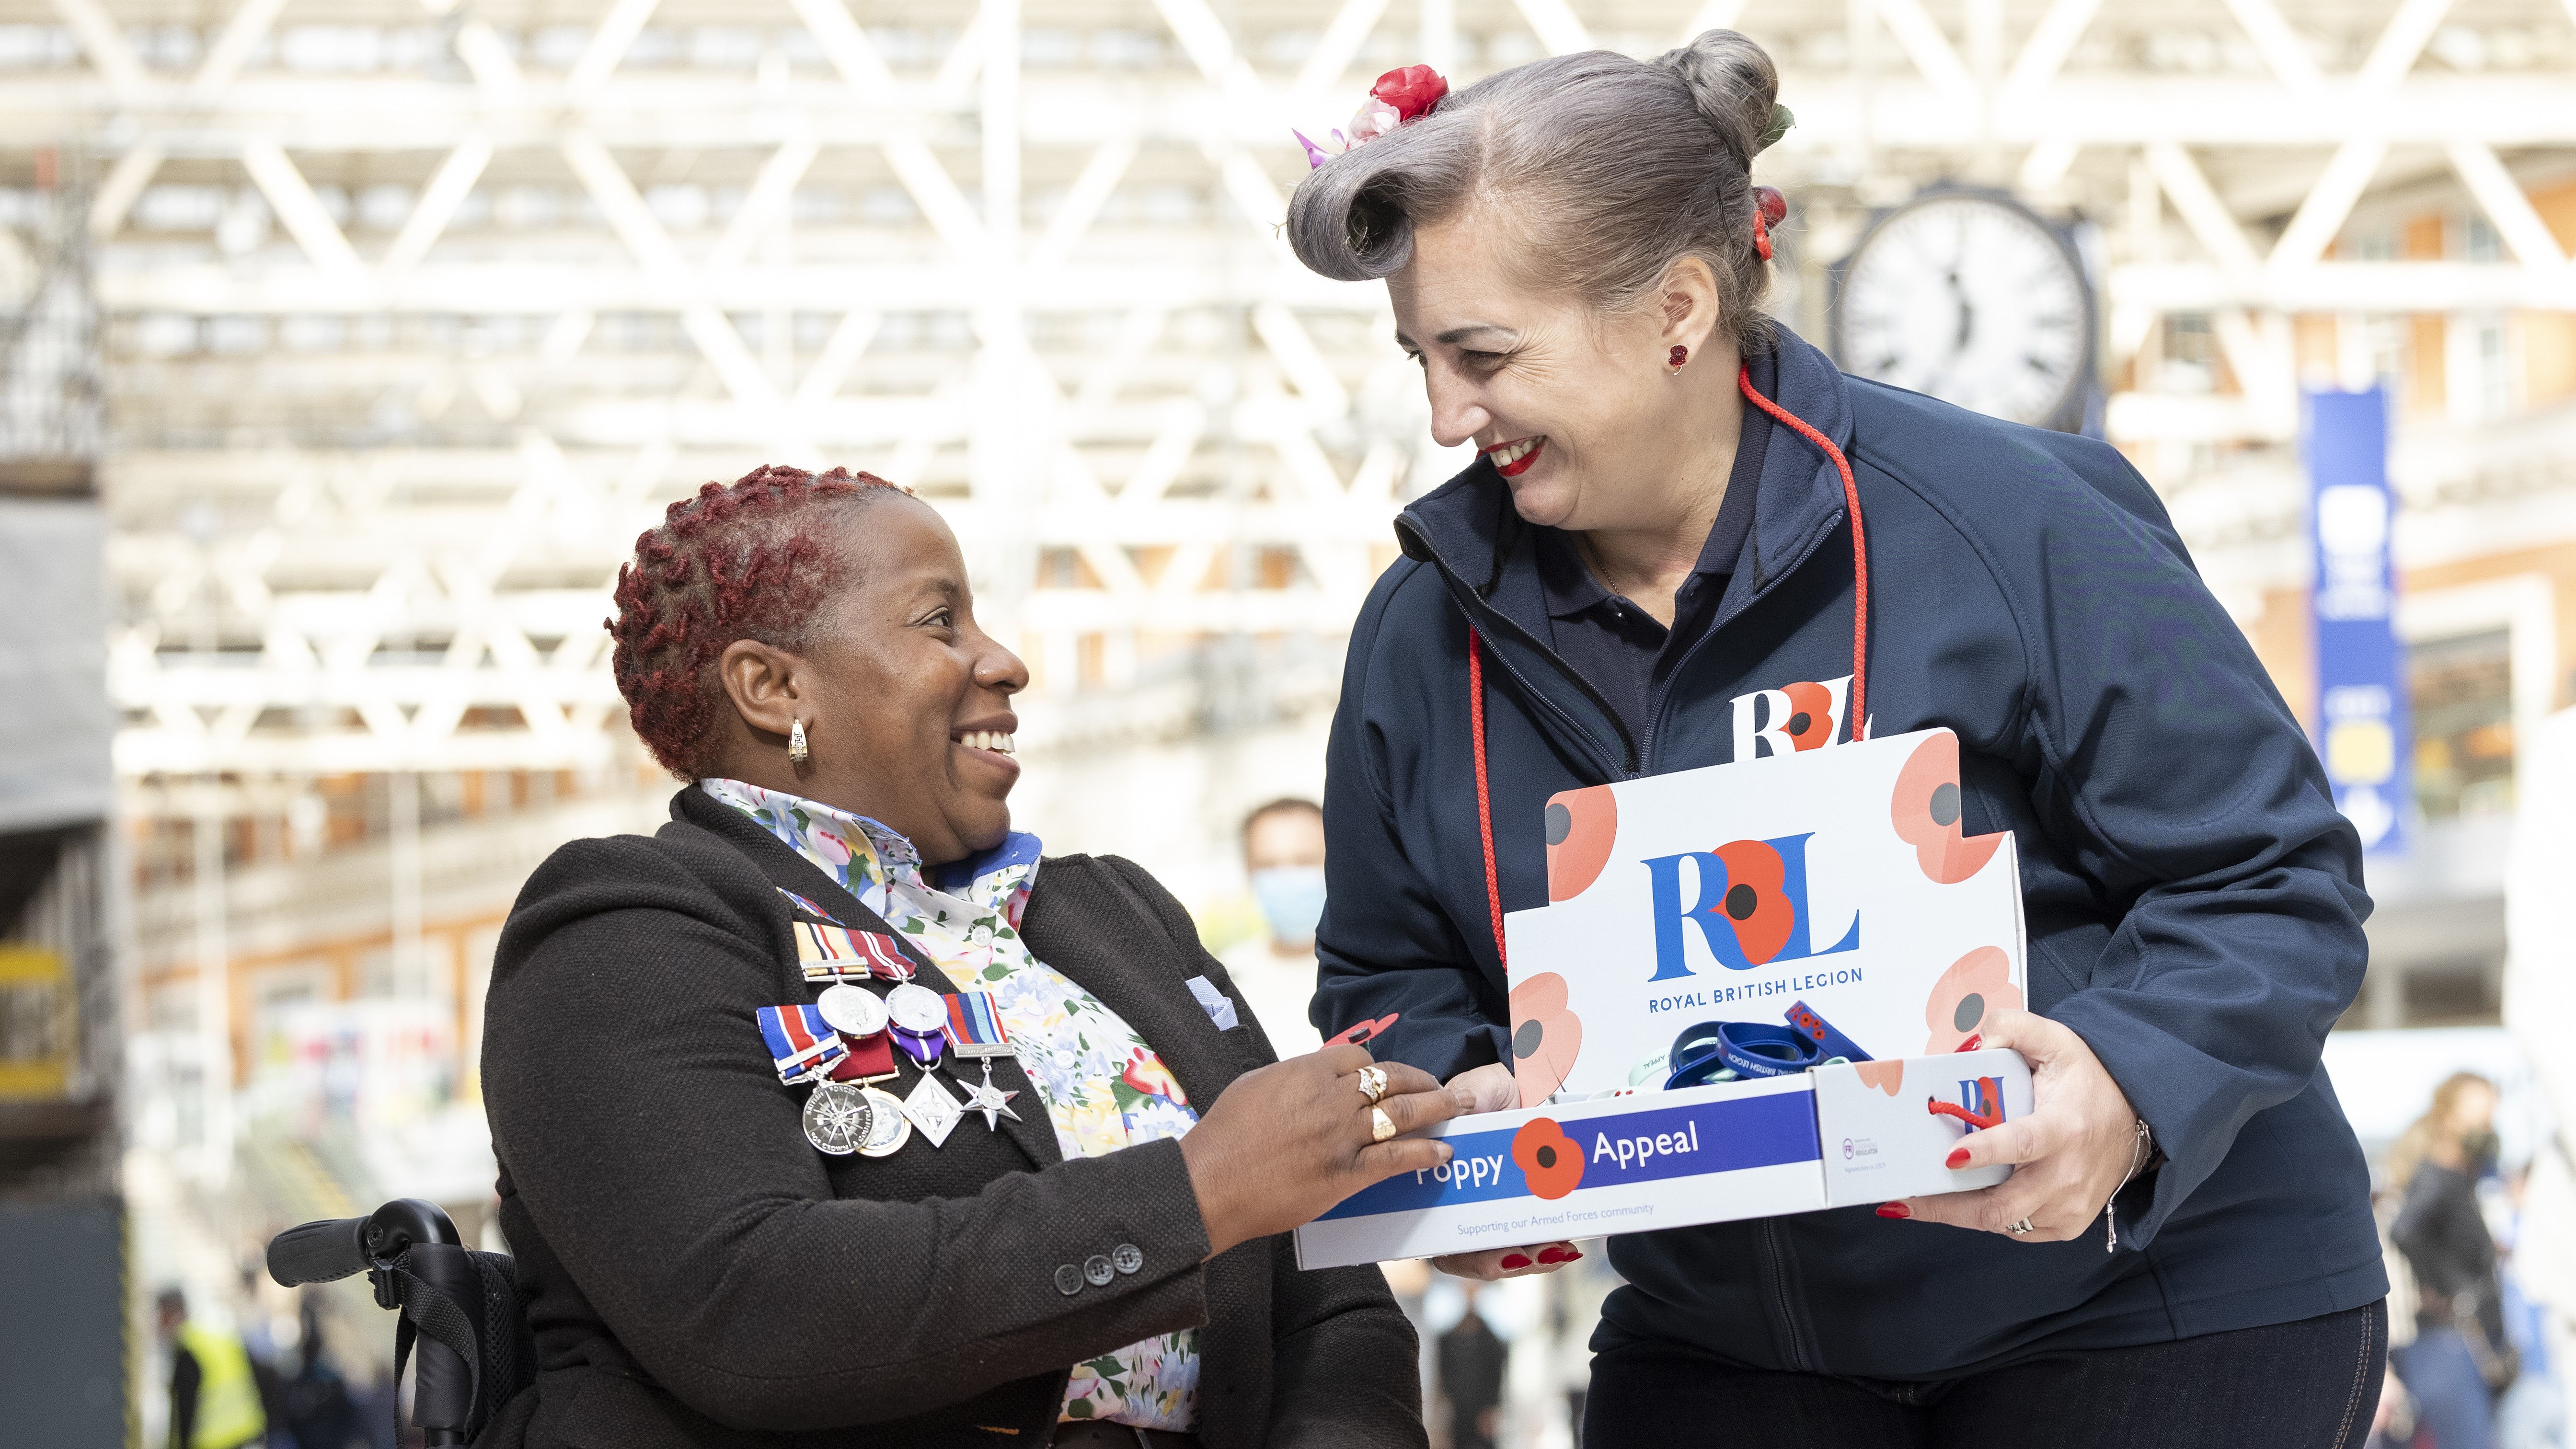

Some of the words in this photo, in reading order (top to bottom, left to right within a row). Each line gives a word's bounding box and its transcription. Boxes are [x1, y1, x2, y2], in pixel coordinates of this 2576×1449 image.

[1650, 993, 1706, 1013] ROYAL
[1714, 980, 1786, 1004] BRITISH
[1794, 967, 1863, 991] LEGION
[1643, 1054, 1665, 1070] APPEAL
[1727, 1053, 1750, 1068] LEGION
[1749, 1062, 1776, 1076] BRITISH
[1592, 1120, 1699, 1169] Appeal
[1458, 1221, 1509, 1236] Supporting
[1511, 1219, 1528, 1229] our
[1531, 1212, 1564, 1226] Armed
[1566, 1211, 1598, 1222] Forces
[1601, 1203, 1654, 1218] community
